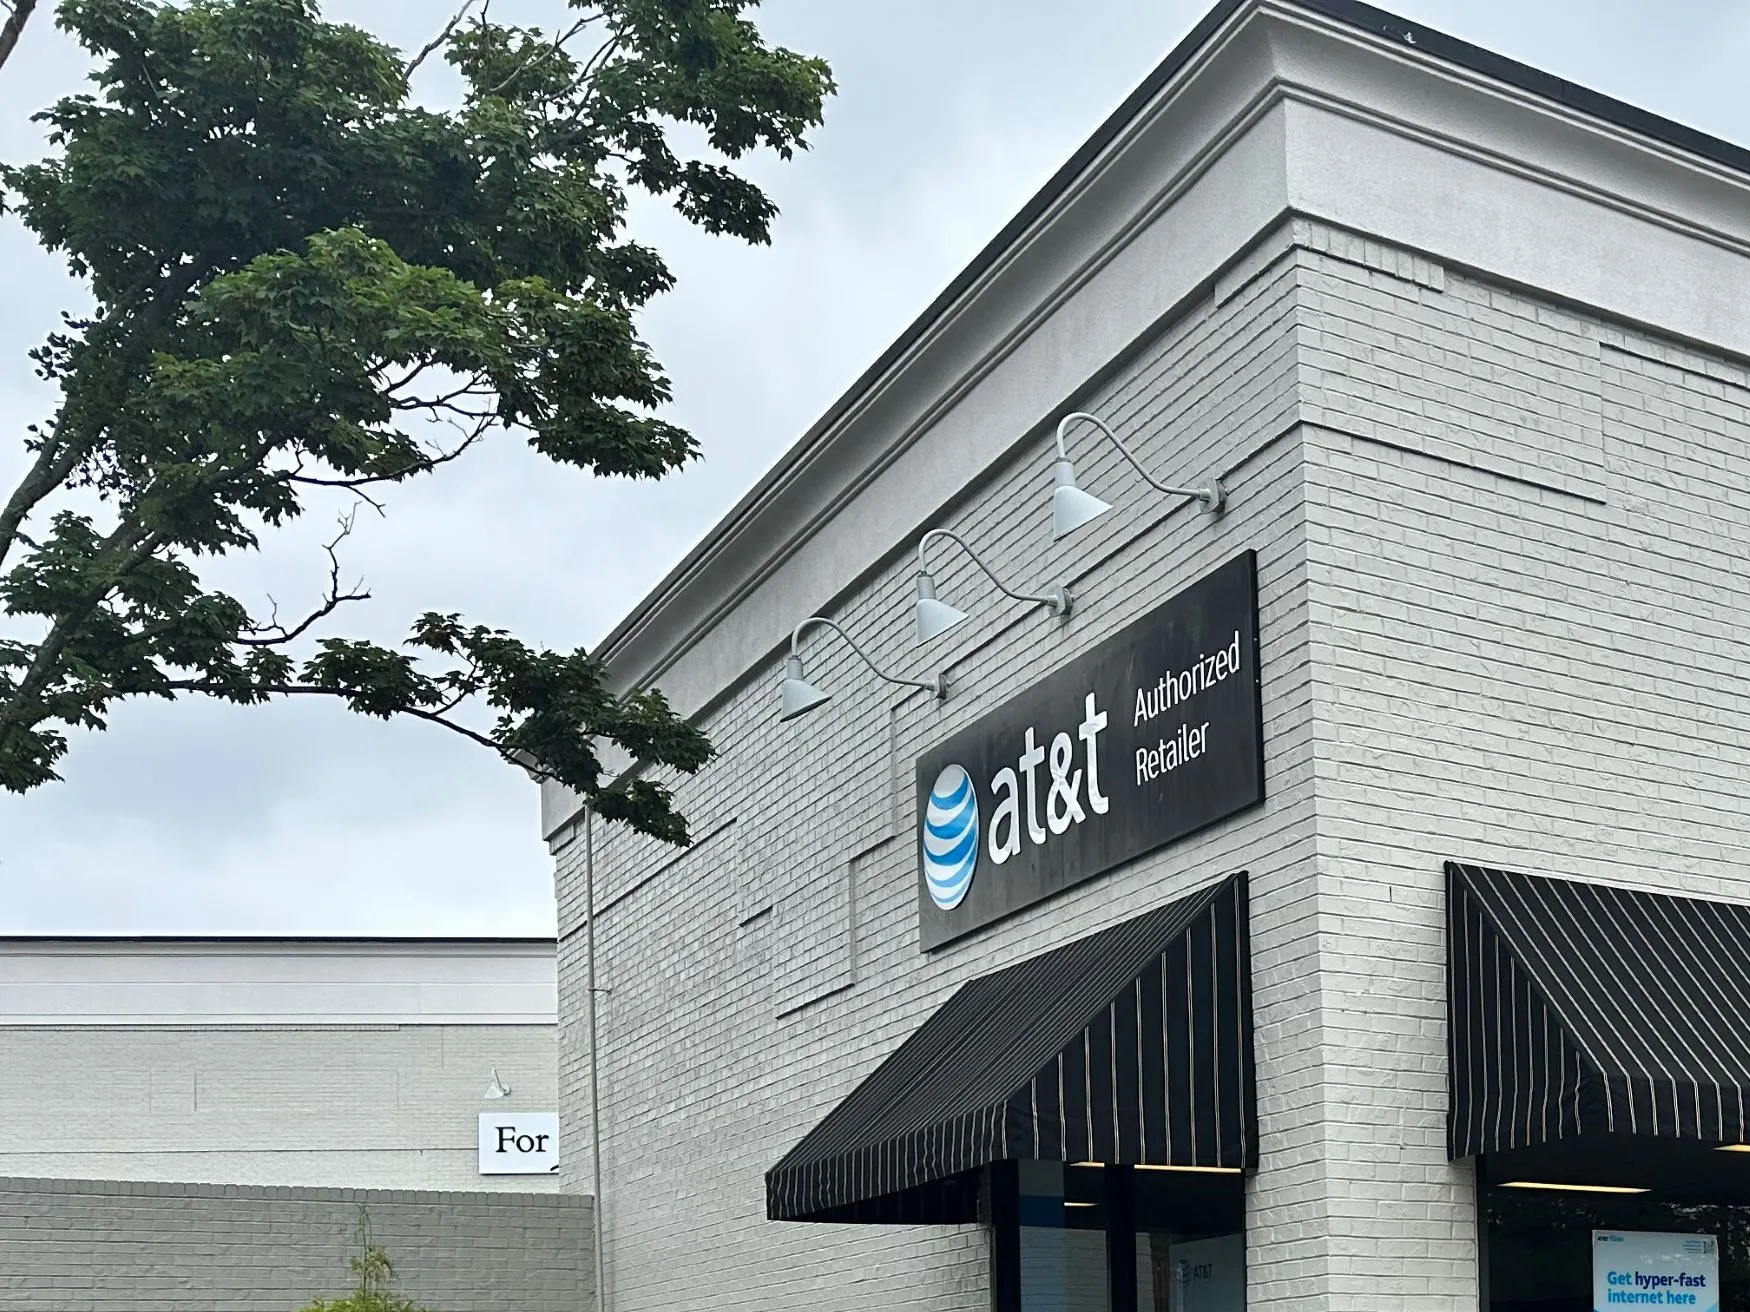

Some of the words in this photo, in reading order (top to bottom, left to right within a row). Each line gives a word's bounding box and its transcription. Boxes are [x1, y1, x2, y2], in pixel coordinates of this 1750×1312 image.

[1133, 630, 1241, 727] Authorized
[1136, 721, 1210, 786] Retailer
[988, 692, 1109, 865] at&t
[495, 1126, 550, 1153] For
[1194, 1263, 1213, 1281] AT&T
[1607, 1271, 1632, 1286] Get
[1635, 1271, 1706, 1290] hyper-fast
[1607, 1288, 1664, 1304] internet
[1666, 1290, 1696, 1305] here
